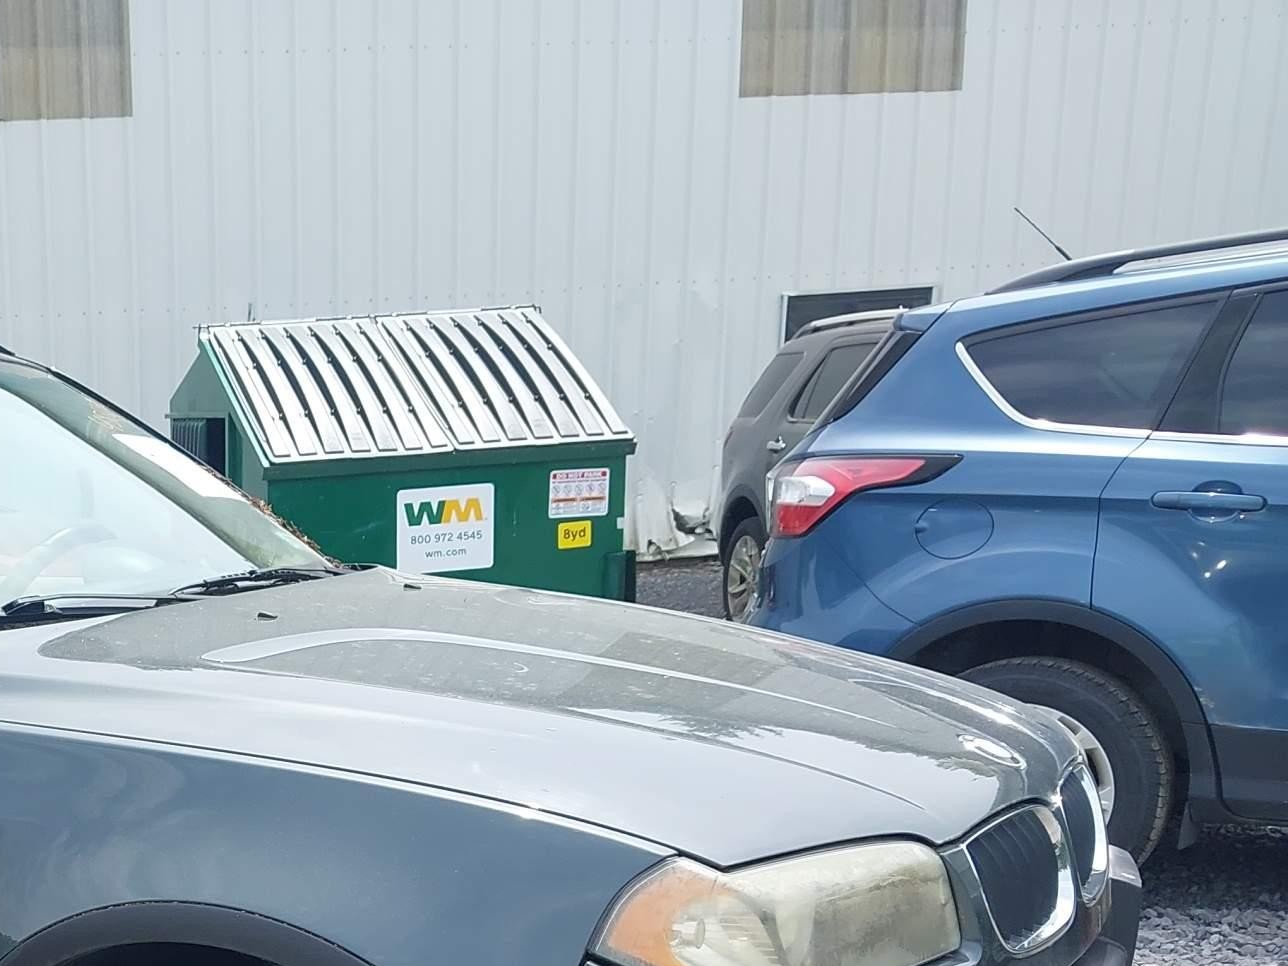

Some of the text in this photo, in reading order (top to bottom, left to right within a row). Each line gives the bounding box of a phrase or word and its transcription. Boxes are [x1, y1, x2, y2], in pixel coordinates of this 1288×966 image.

[404, 497, 483, 526] WM
[410, 530, 483, 545] 800 972 4545
[563, 527, 586, 541] 8yd
[425, 548, 467, 558] wm.com
